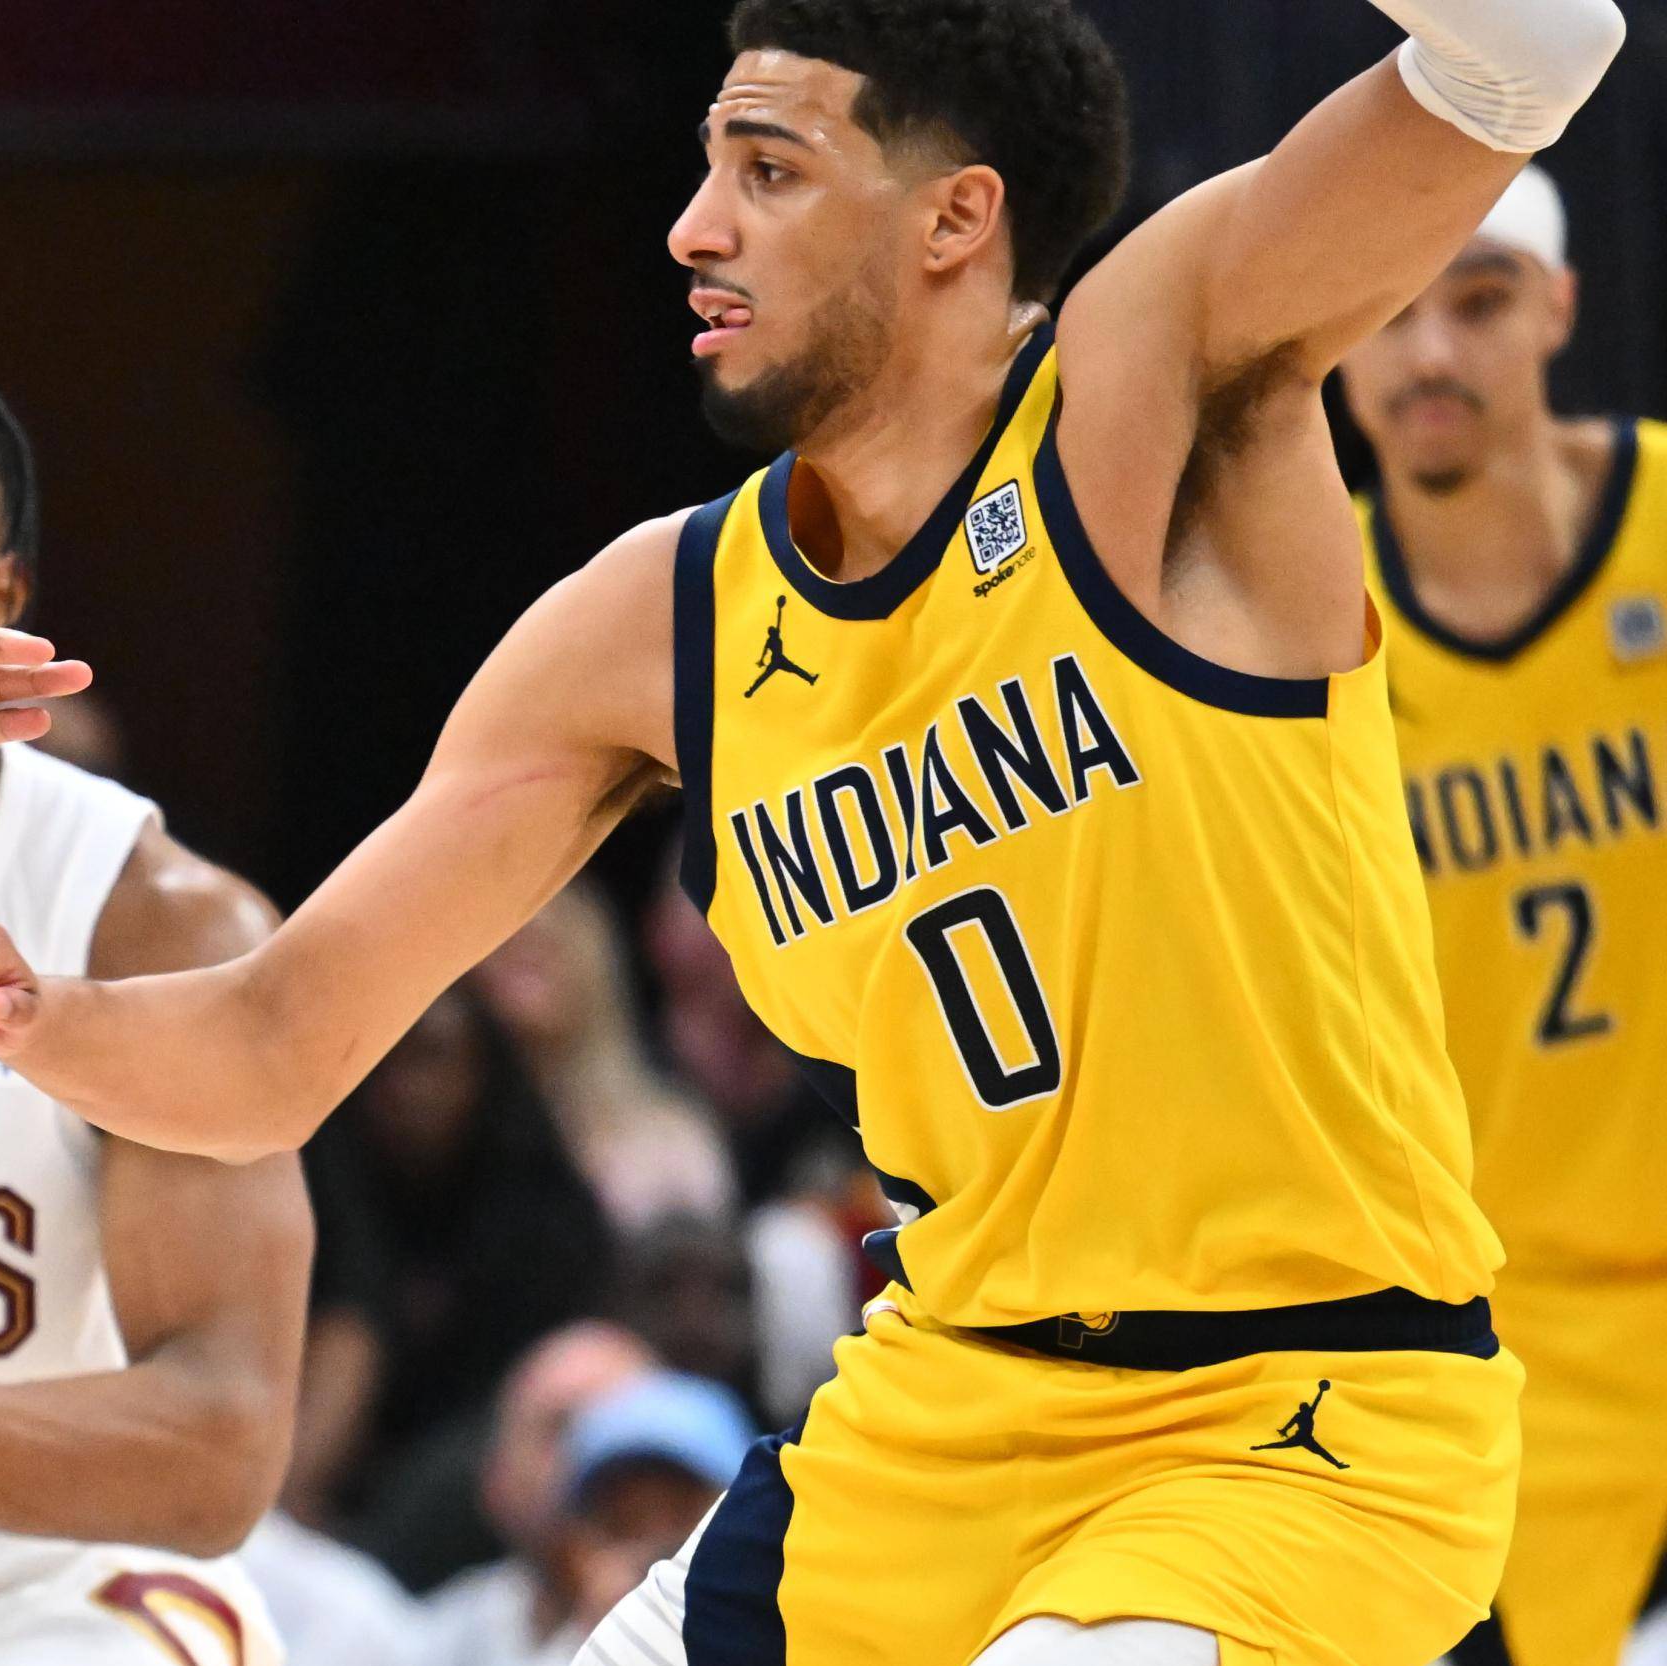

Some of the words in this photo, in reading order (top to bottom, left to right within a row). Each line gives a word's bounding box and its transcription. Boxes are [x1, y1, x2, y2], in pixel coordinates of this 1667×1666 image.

[973, 546, 1036, 597] spokenote
[728, 652, 1143, 949] INDIANA
[1405, 729, 1659, 876] NDIAN
[902, 884, 1064, 1113] 0
[1513, 880, 1615, 1049] 2
